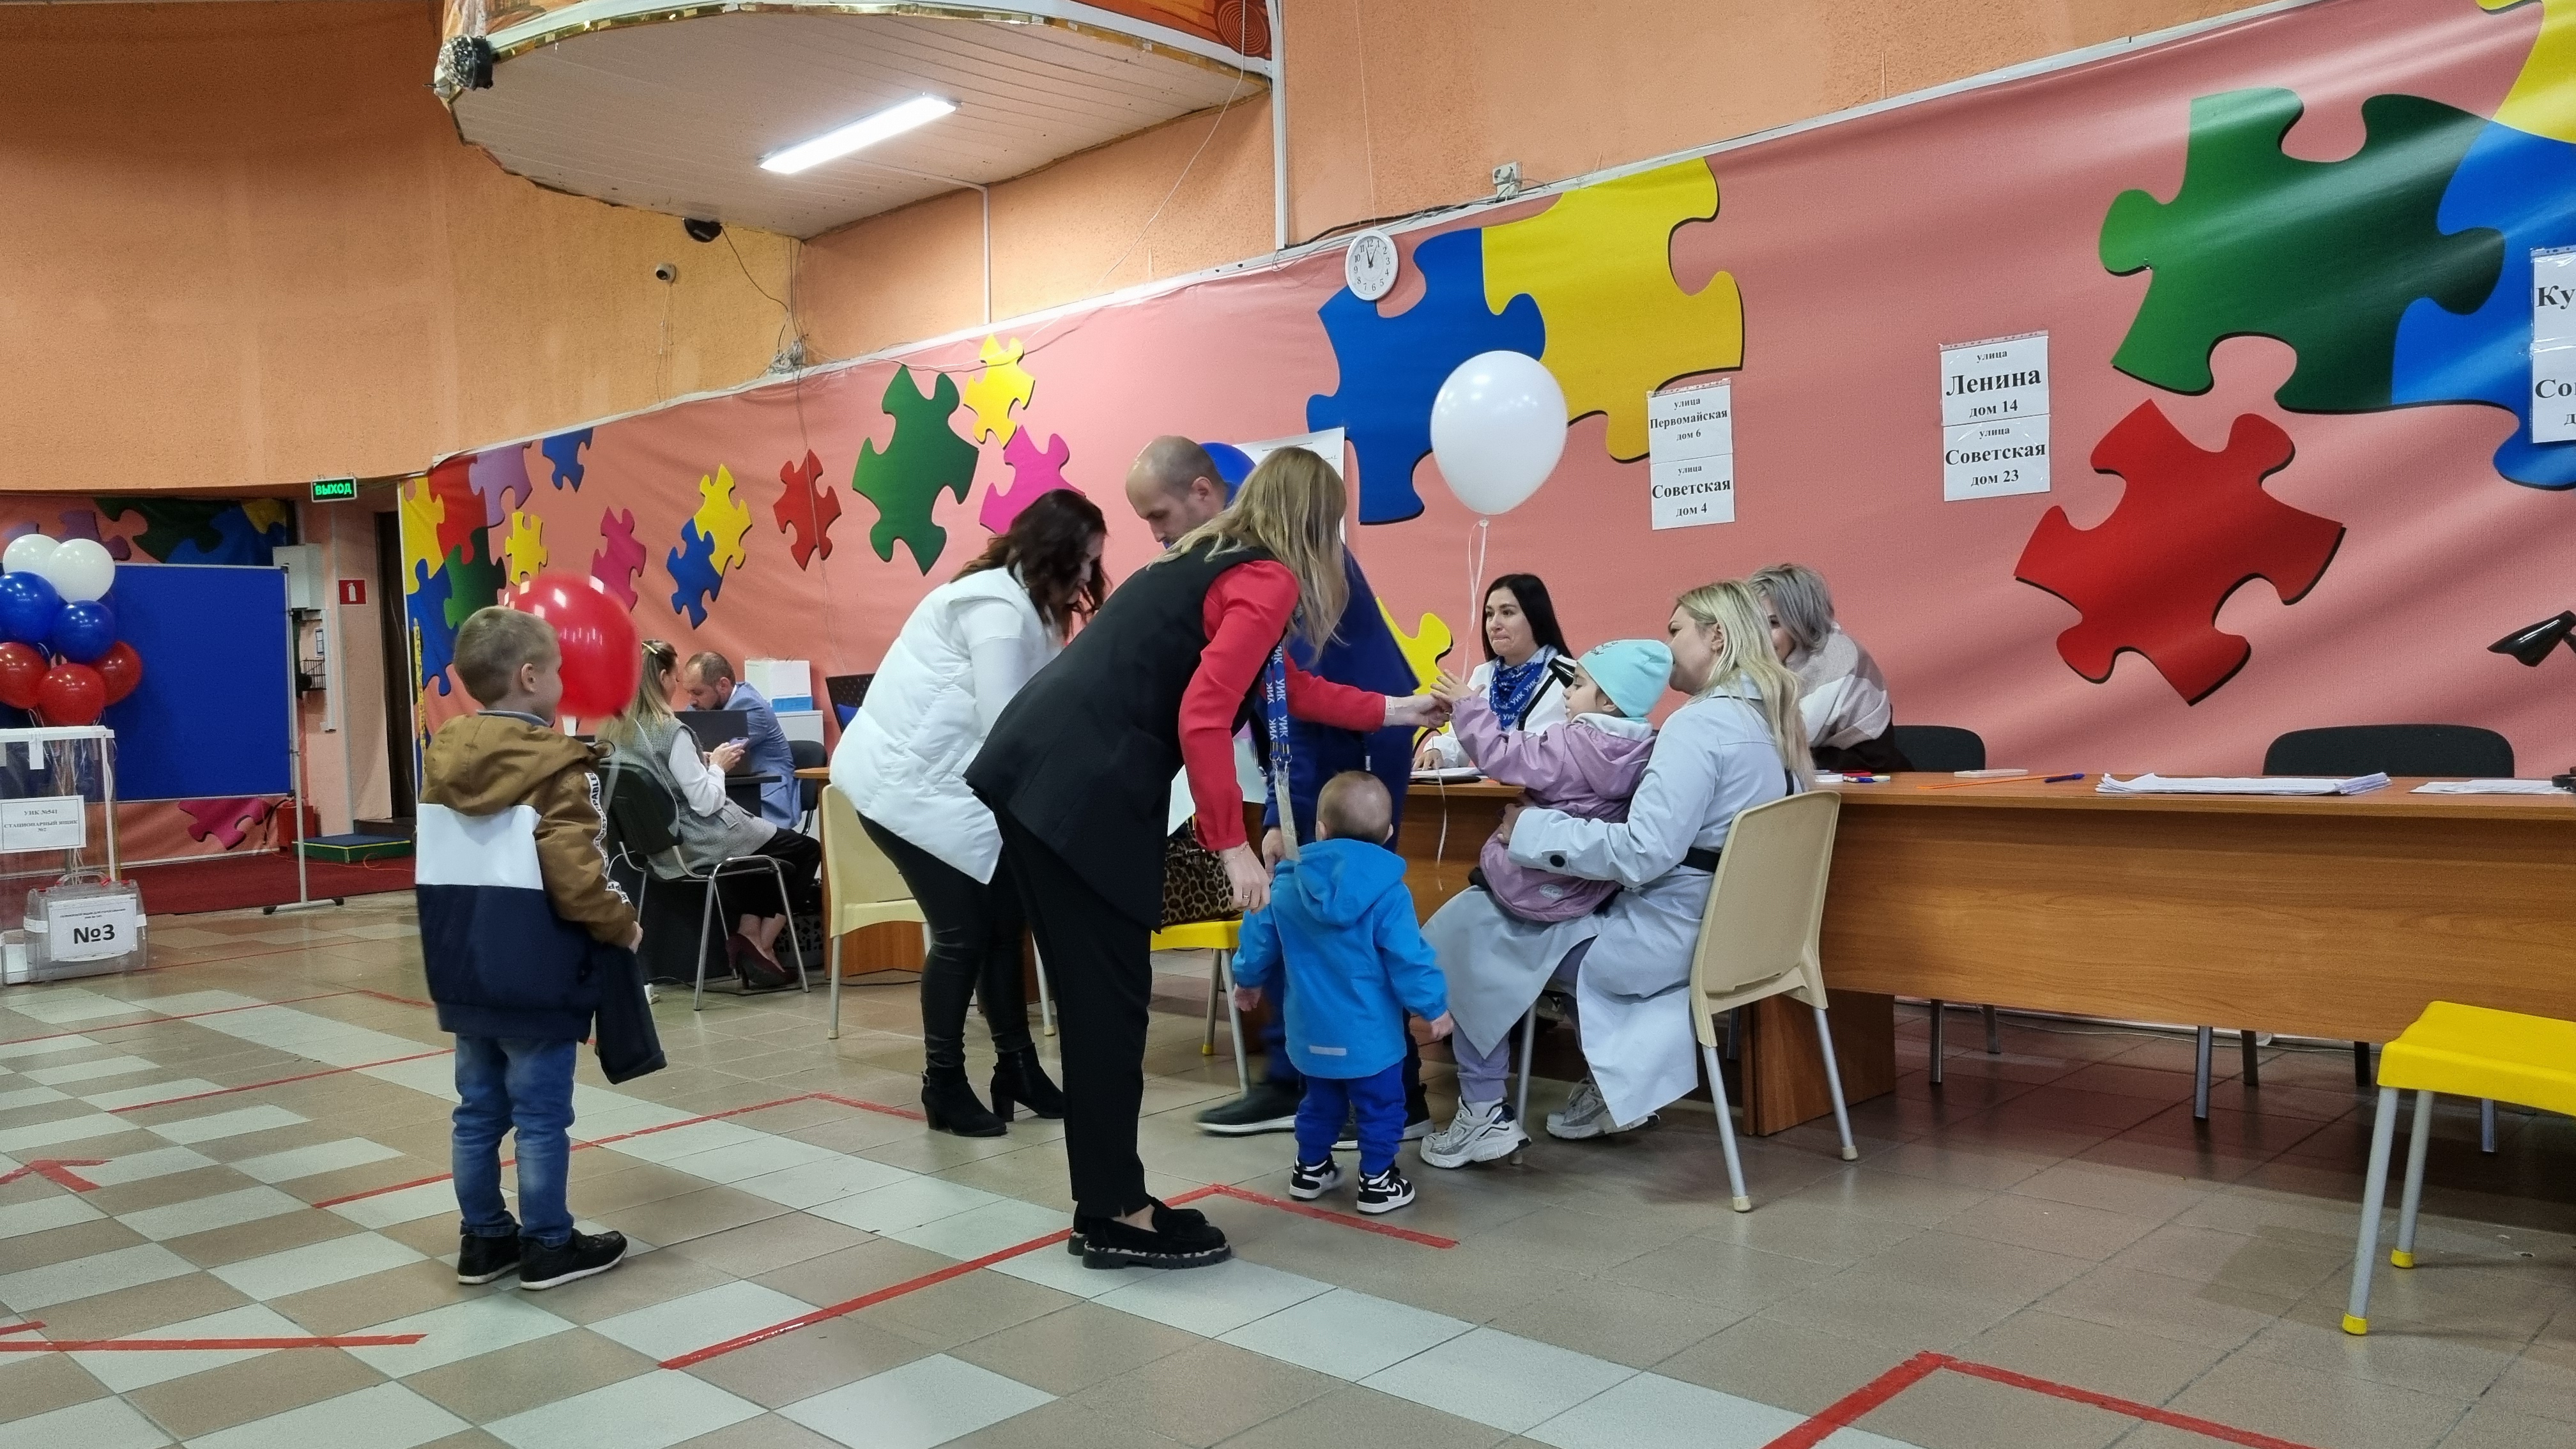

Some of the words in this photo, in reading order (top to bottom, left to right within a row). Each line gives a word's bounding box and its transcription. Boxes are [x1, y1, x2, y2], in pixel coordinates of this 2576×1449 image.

[1367, 239, 1373, 247] 12
[1354, 254, 1360, 263] 10
[1386, 257, 1390, 265] 3
[1354, 265, 1358, 273] 9
[1357, 276, 1361, 284] 8
[1363, 282, 1367, 291] 7
[1372, 283, 1376, 291] 6
[1976, 351, 2007, 364] улица
[1945, 369, 2041, 396] Ленина
[2535, 379, 2576, 399] Со
[1674, 397, 1701, 410] улица
[1969, 404, 1997, 418] дом
[2002, 399, 2018, 413] 14
[1650, 409, 1728, 429] Первомайская
[1676, 431, 1694, 441] дом
[1696, 429, 1701, 438] 6
[1979, 427, 2010, 439] улица
[1945, 443, 2046, 465] Советская
[1678, 465, 1702, 476] улица
[1970, 474, 1998, 487] дом
[2002, 469, 2019, 482] 23
[315, 483, 352, 495] ВЫХОД
[1652, 479, 1731, 499] Советская
[1676, 506, 1698, 517] дом
[1701, 502, 1707, 513] 4
[1275, 678, 1286, 701] УИК
[1524, 678, 1538, 692] УИК
[1266, 682, 1275, 705] УИК
[1510, 691, 1525, 705] УИК
[1268, 718, 1278, 740] УИК
[1278, 715, 1289, 737] УИК
[73, 924, 115, 944] №3
